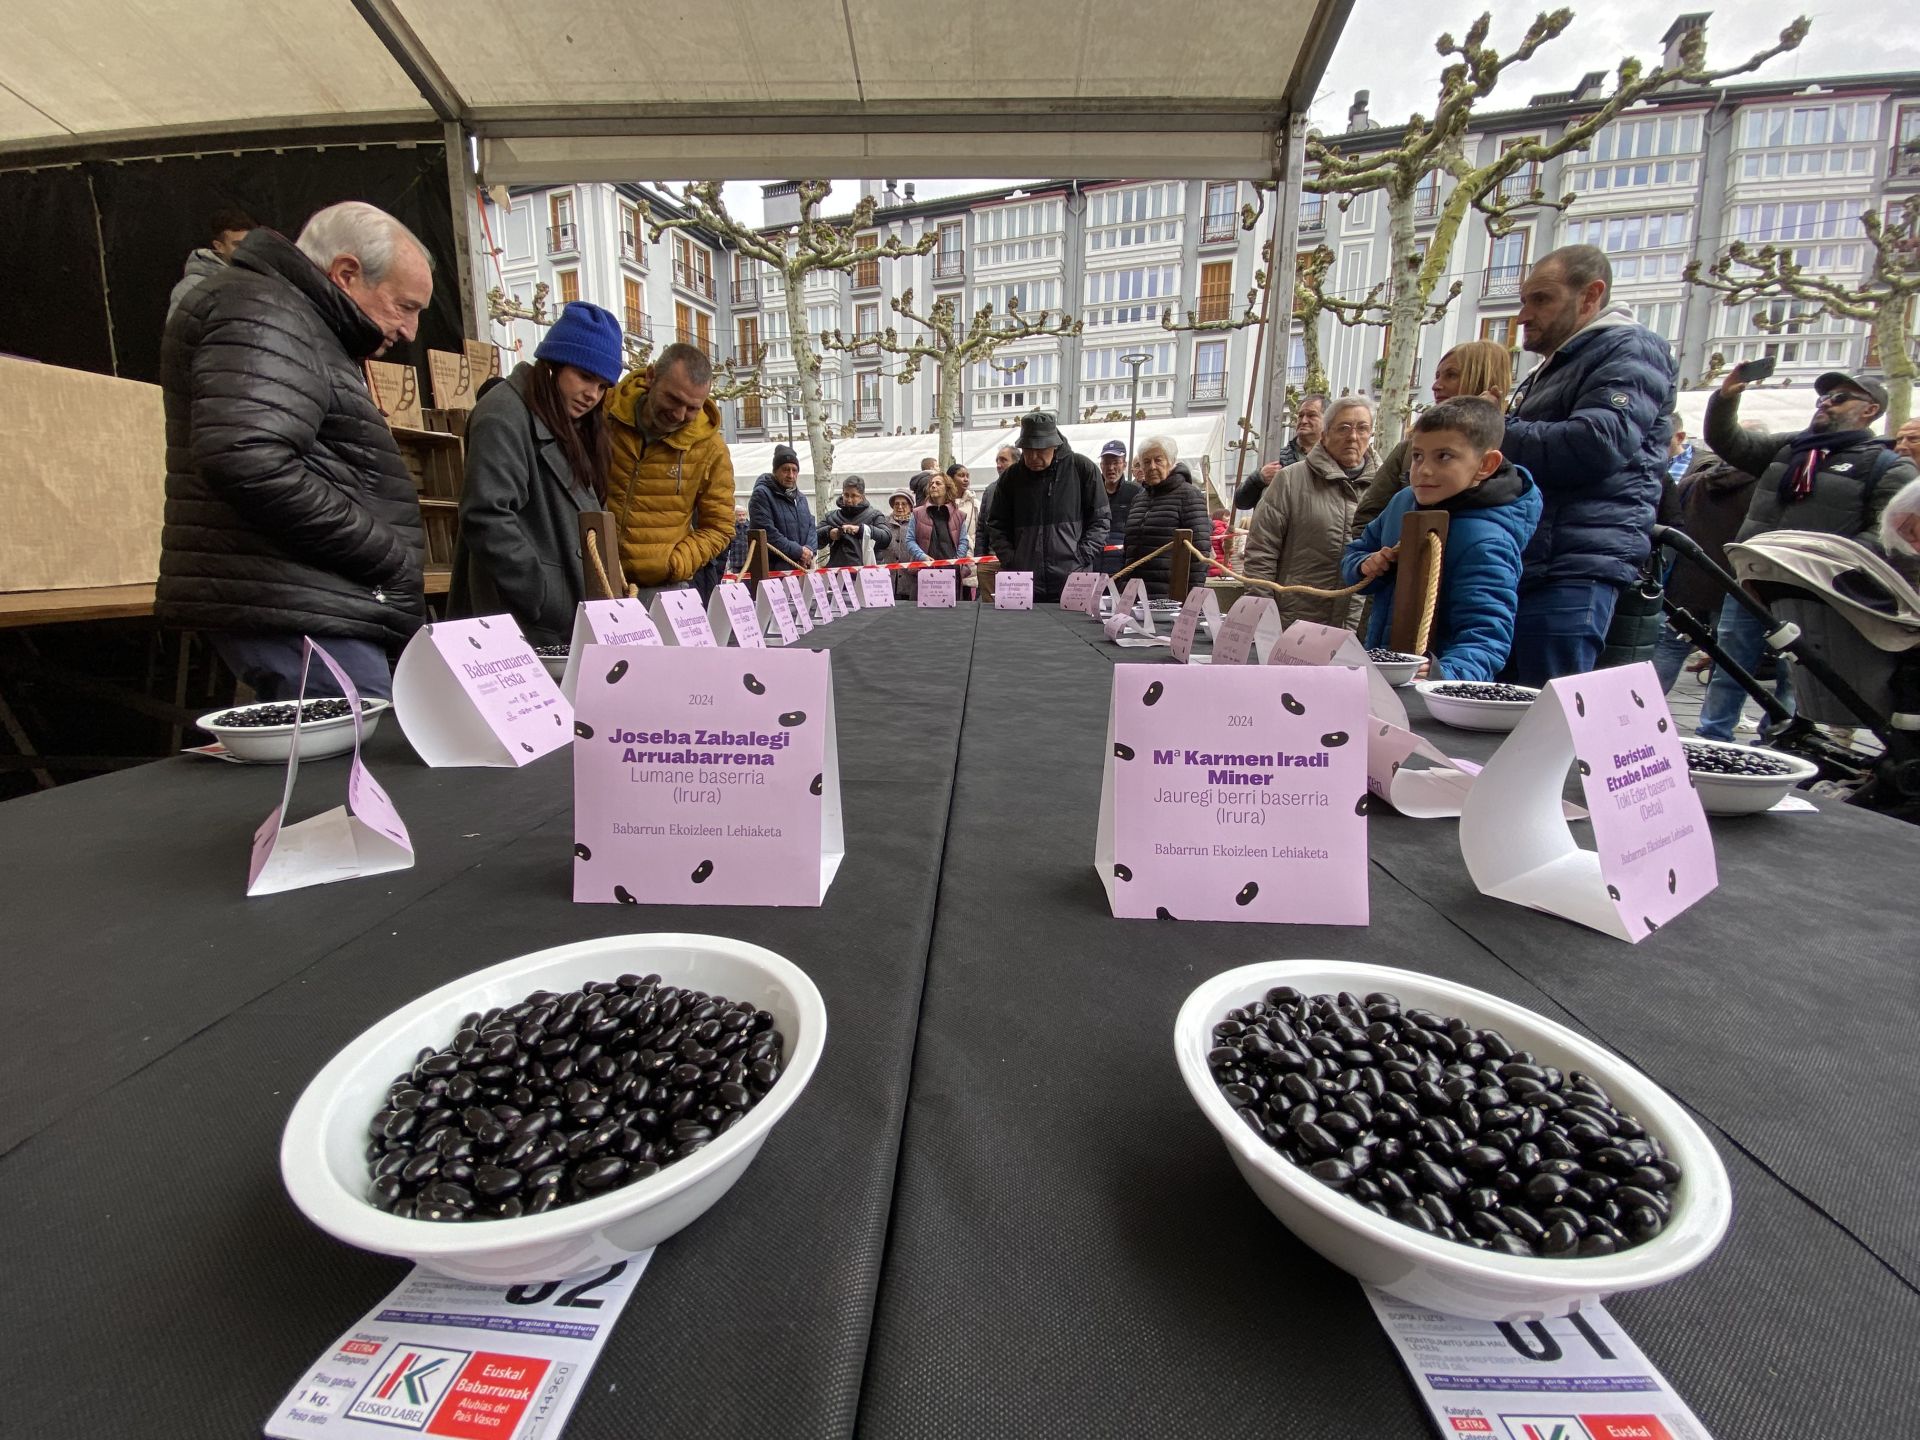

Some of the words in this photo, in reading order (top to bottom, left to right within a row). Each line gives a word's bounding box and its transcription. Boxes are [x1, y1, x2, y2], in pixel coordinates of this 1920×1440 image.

[462, 653, 534, 680] Babarrunaren
[496, 671, 527, 690] Festa
[688, 694, 714, 706] 2024
[1227, 715, 1254, 727] 2024
[608, 728, 691, 746] Joseba
[695, 729, 790, 750] Zabalegi
[622, 747, 775, 766] Arruabarrena
[1184, 750, 1274, 768] Karmen
[1277, 751, 1329, 768] Iradi
[1613, 744, 1657, 769] Beristain
[631, 767, 694, 785] Lumane
[699, 768, 766, 786] baserria
[1207, 769, 1274, 786] Miner
[1606, 770, 1642, 793] Etxabe
[1641, 757, 1672, 780] Anaiak
[673, 786, 722, 805] (Irura)
[1154, 787, 1213, 808] Jauregi
[1217, 787, 1257, 806] berri
[1261, 788, 1329, 807] baserria
[1613, 790, 1633, 811] Toki
[1631, 786, 1649, 805] Eder
[1216, 807, 1266, 826] (Irura)
[1640, 801, 1664, 823] (Deba)
[612, 823, 665, 836] Babarrun
[669, 824, 723, 837] Ekoizleen
[727, 824, 782, 838] Lehiaketa
[1154, 843, 1209, 857] Babarrun
[1213, 844, 1268, 858] Ekoizleen
[1272, 845, 1329, 860] Lehiaketa
[347, 1342, 376, 1353] EXTRA
[482, 1363, 527, 1381] Euskal
[298, 1390, 308, 1401] 1
[455, 1378, 532, 1401] Babarrunak
[354, 1401, 391, 1418] EUSKO
[391, 1406, 425, 1424] LABEL
[458, 1397, 493, 1412] Alubias
[494, 1403, 511, 1414] del
[474, 1413, 501, 1427] Vasco
[1456, 1419, 1487, 1430] EXTRA
[1607, 1425, 1652, 1437] Euskal
